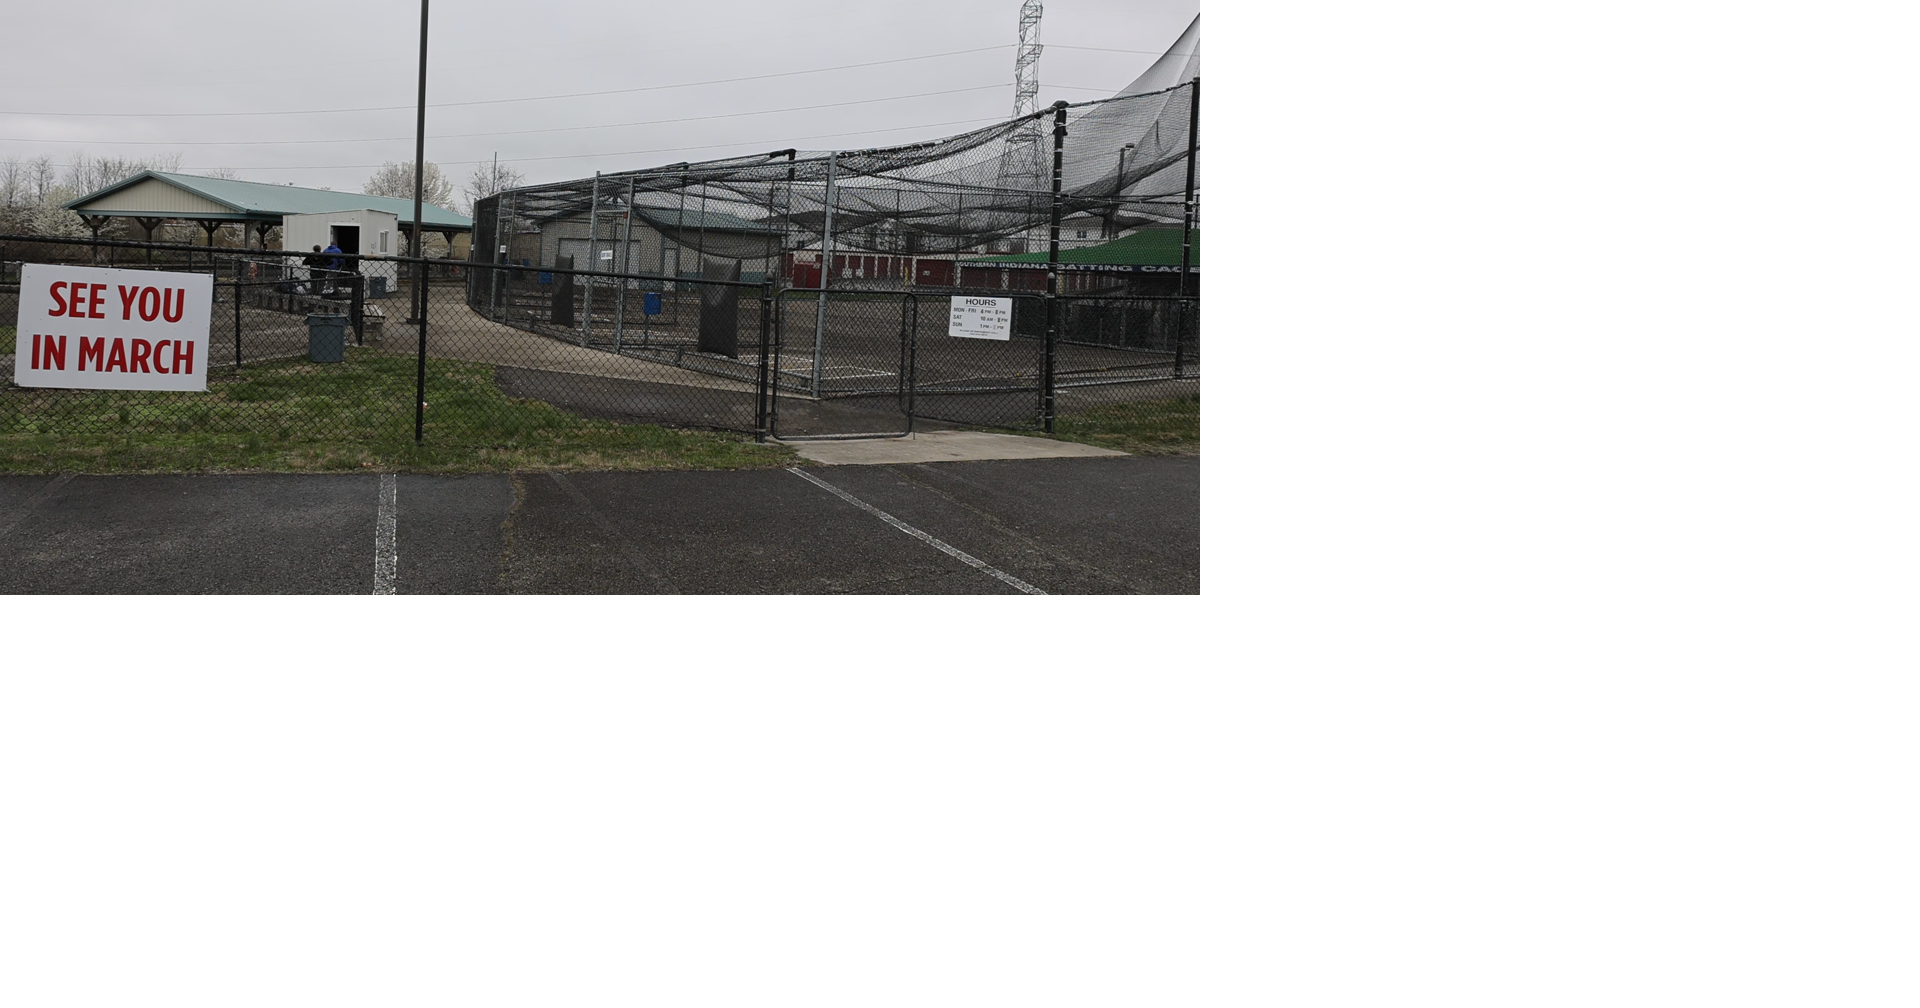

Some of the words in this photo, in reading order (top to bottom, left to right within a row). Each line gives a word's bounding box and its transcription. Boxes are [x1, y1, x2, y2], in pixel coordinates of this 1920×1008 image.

[1056, 263, 1133, 272] BATTING
[48, 281, 107, 319] SEE
[117, 284, 185, 323] YOU
[965, 298, 997, 306] HOURS
[31, 334, 67, 371] IN
[77, 336, 195, 375] MARCH
